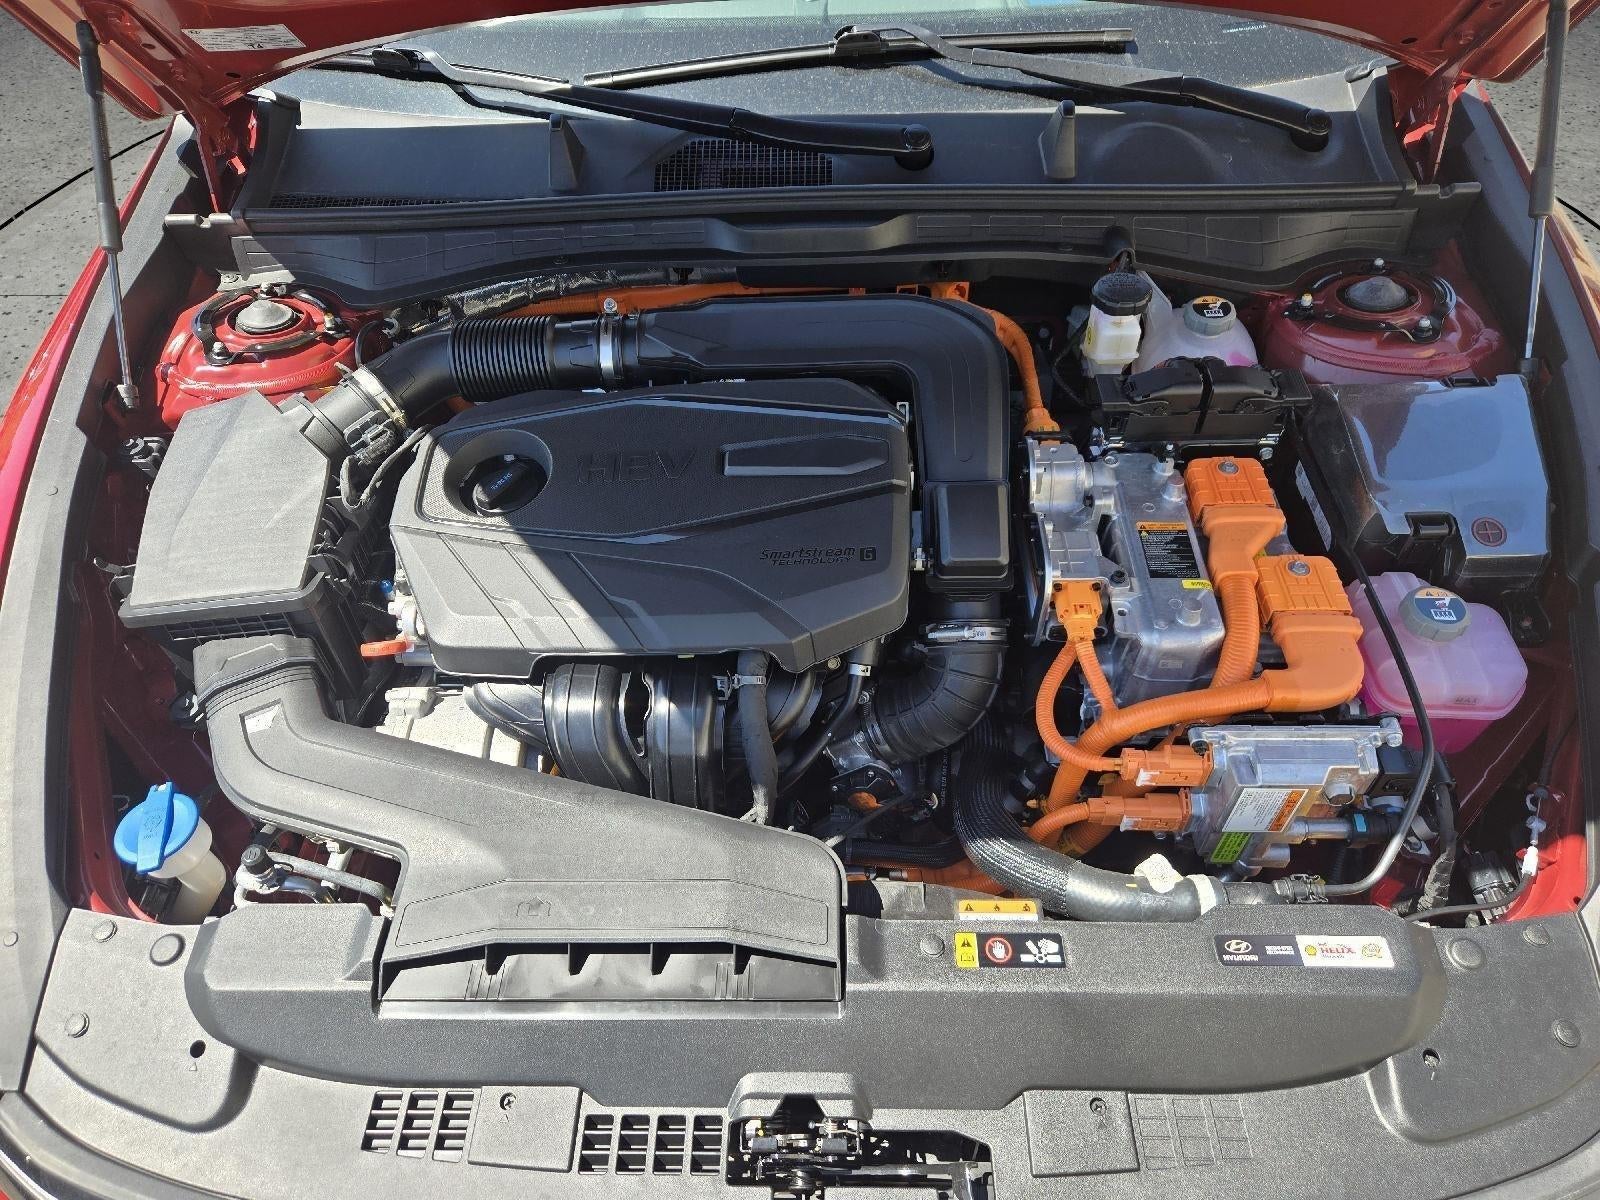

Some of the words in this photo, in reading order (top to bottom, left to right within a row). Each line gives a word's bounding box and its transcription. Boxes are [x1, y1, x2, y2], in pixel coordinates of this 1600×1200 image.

[759, 546, 856, 560] Smartstream
[771, 556, 853, 566] TECHNOLOGY
[1319, 946, 1355, 954] HELIX
